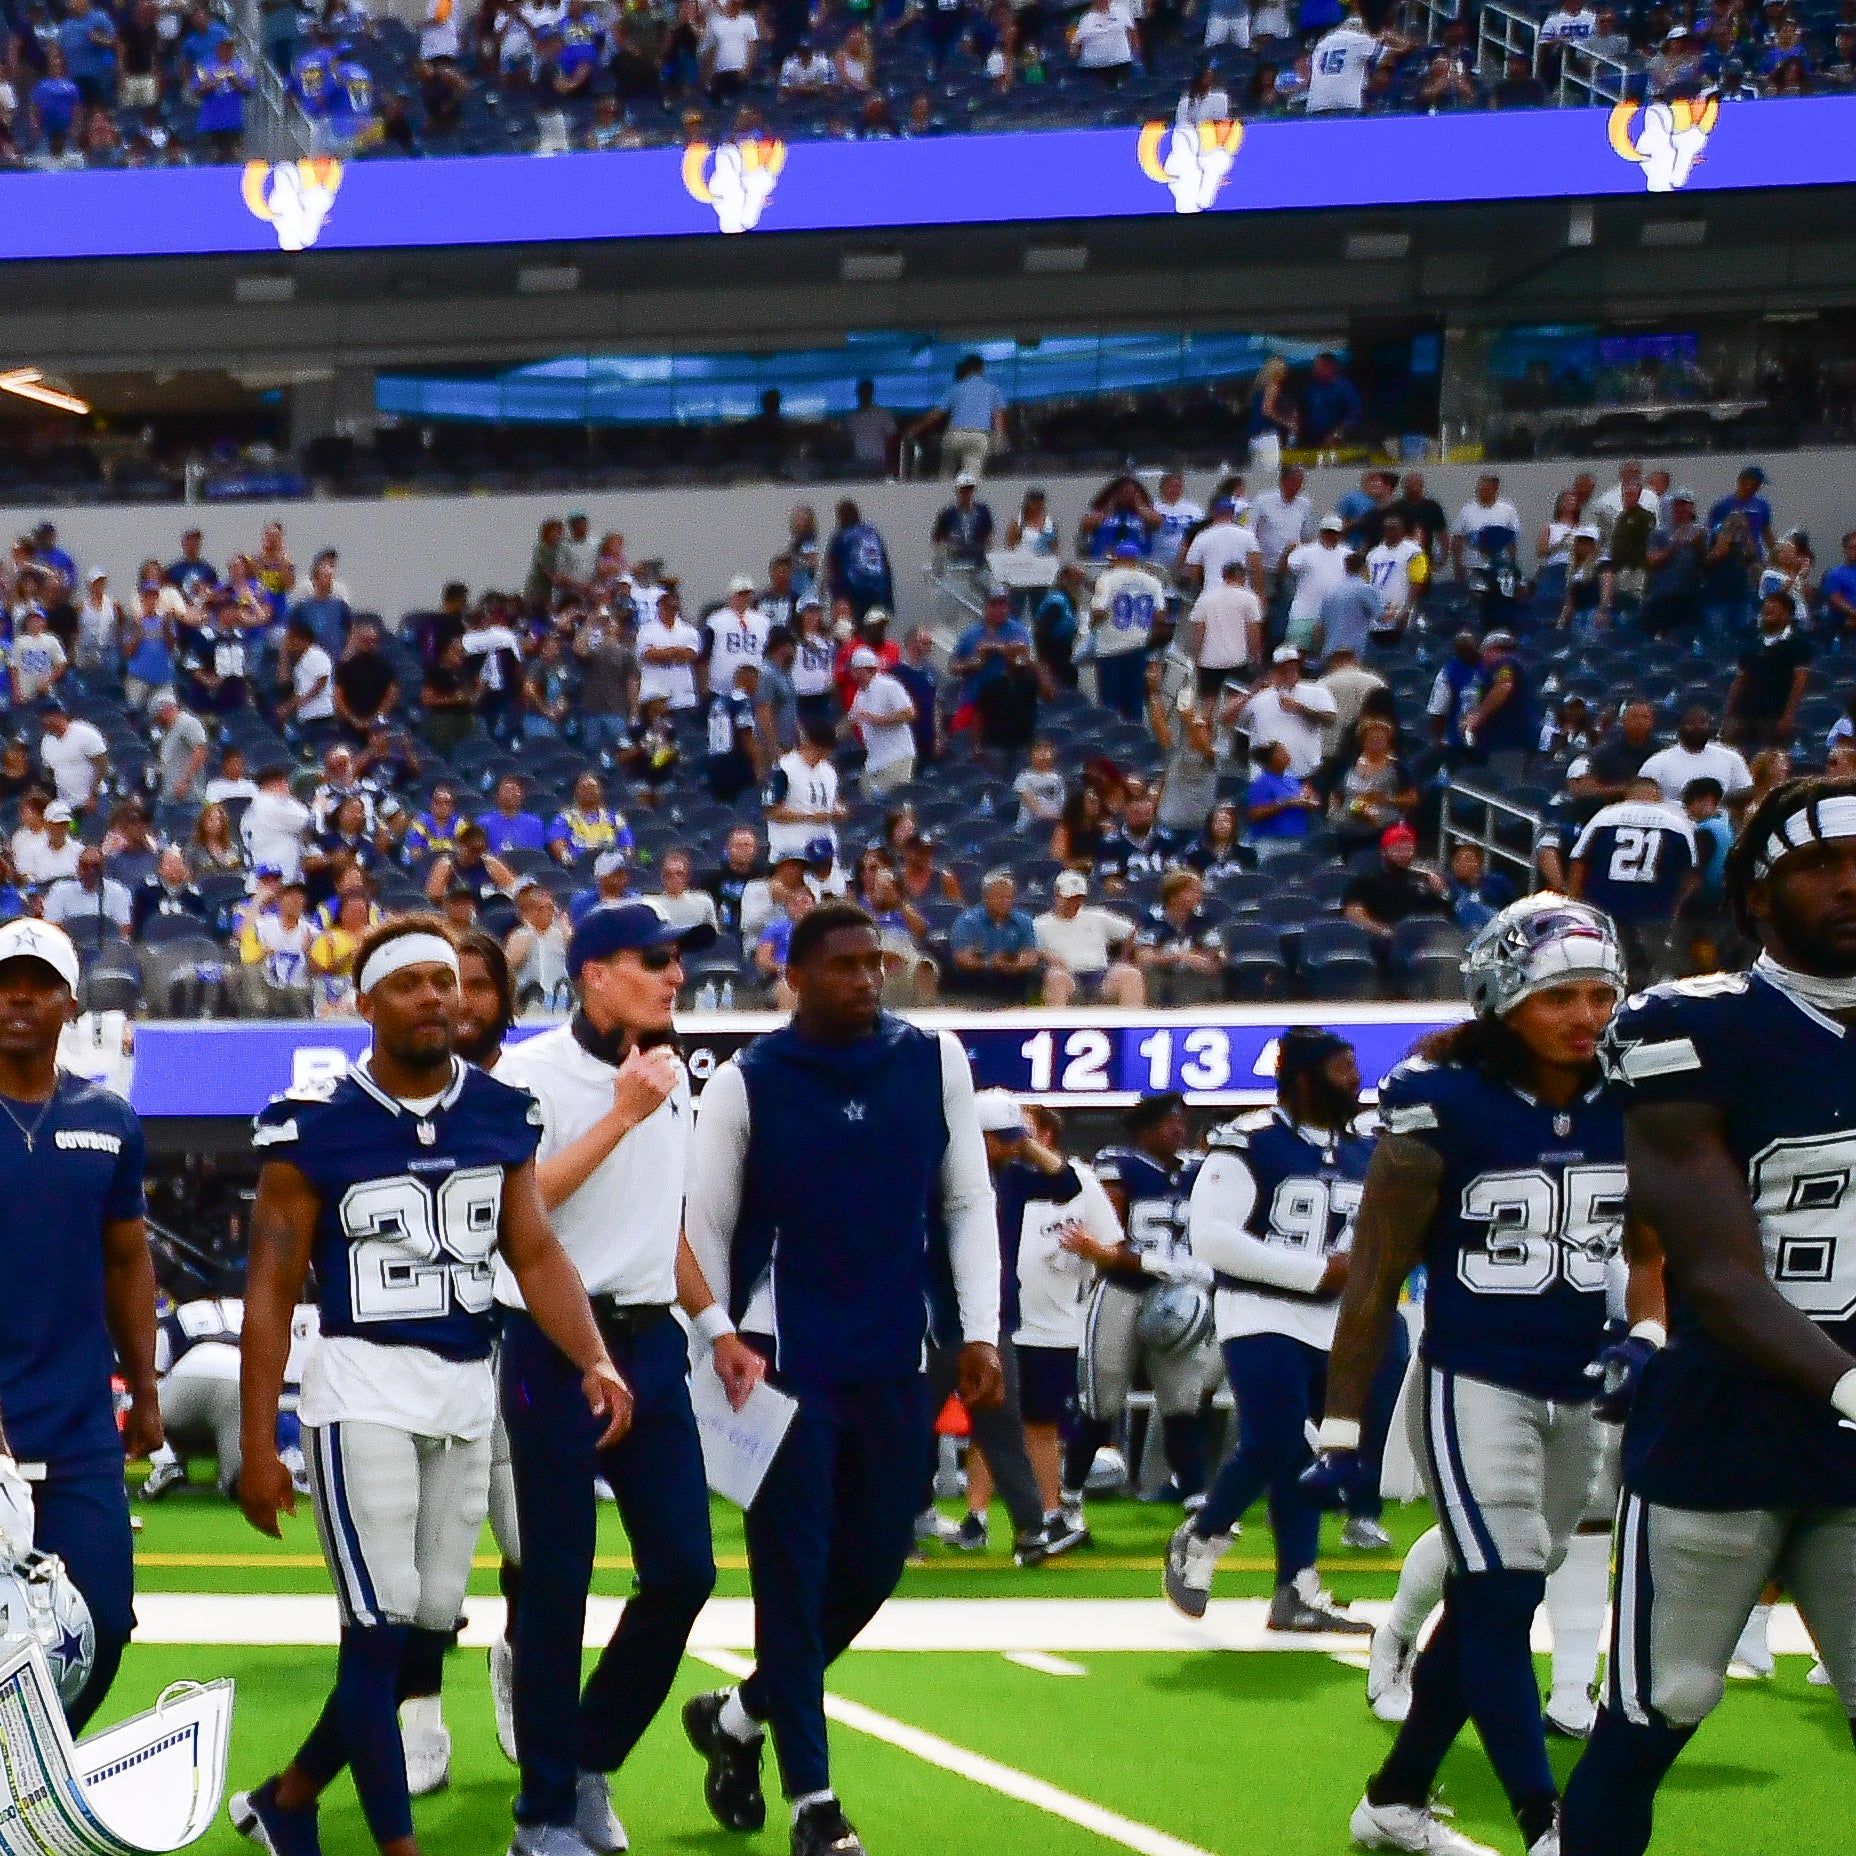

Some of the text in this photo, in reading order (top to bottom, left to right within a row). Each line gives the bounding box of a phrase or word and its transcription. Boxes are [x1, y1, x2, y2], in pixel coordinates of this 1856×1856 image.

[1608, 826, 1662, 882] 21
[1021, 1029, 1111, 1090] 12
[1140, 1028, 1231, 1090] 13
[339, 1164, 505, 1324] 29
[1457, 1162, 1629, 1295] 35
